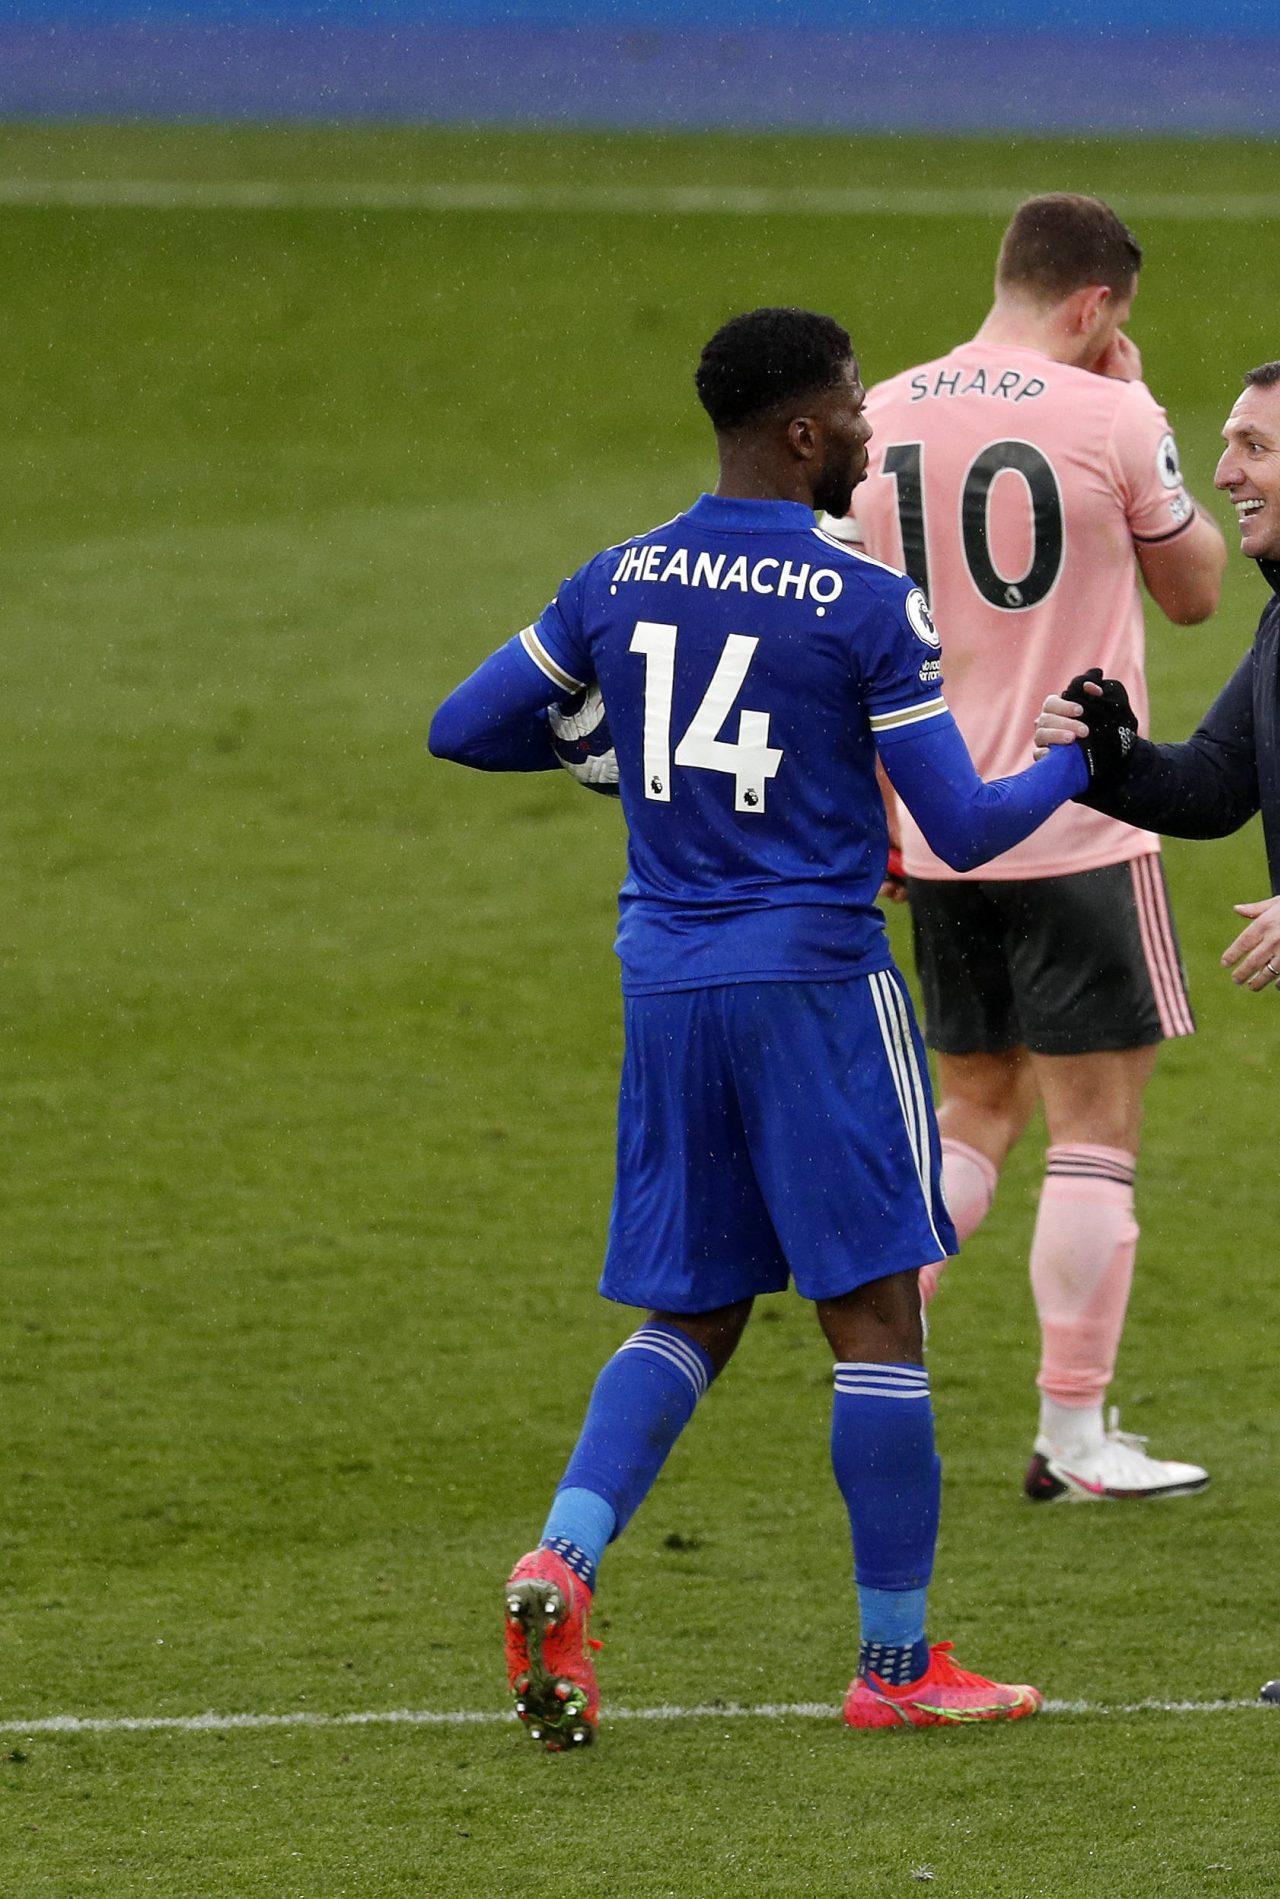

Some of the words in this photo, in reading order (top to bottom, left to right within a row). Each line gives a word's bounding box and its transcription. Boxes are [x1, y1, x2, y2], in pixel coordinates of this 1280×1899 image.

[910, 368, 1047, 404] SHARP
[879, 437, 1065, 613] 10
[629, 621, 783, 813] 14
